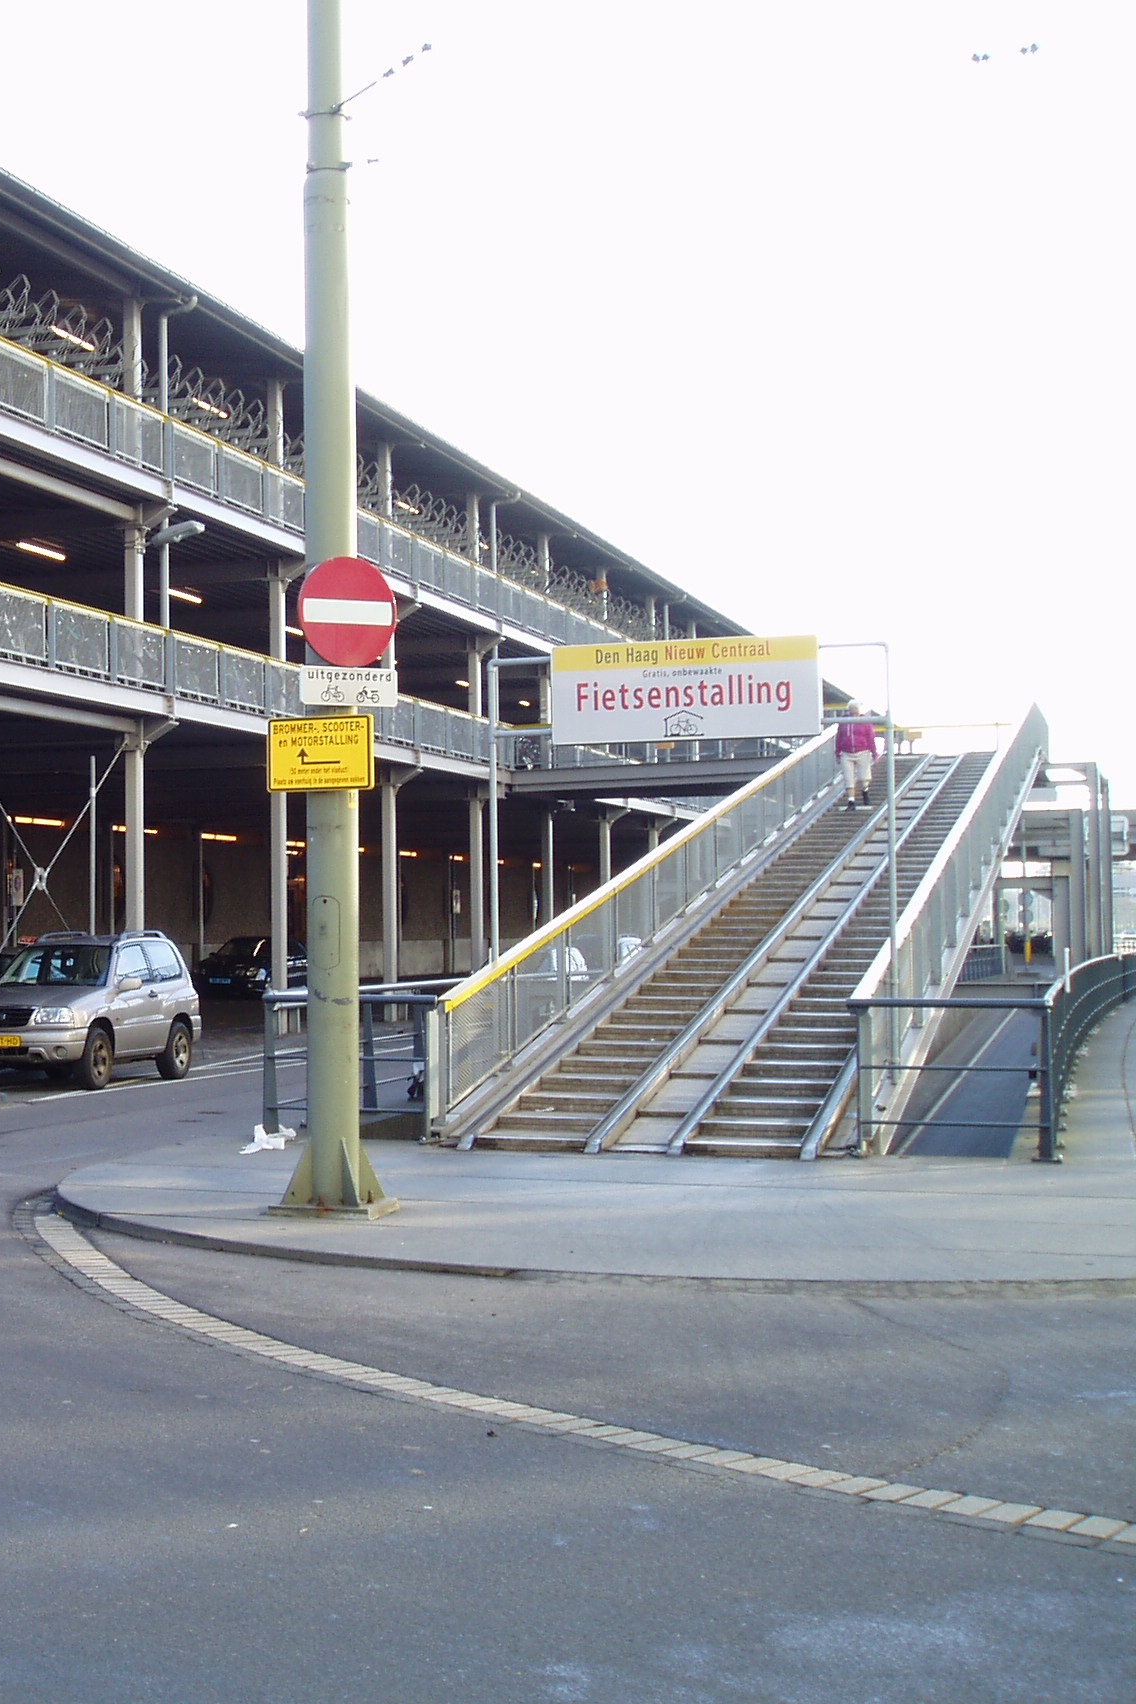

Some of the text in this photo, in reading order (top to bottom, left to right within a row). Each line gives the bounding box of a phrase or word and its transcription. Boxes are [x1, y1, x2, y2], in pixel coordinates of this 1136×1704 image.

[595, 640, 772, 665] Den Haag Nieuw Centraal
[307, 669, 392, 683] uitgezonderd
[642, 666, 723, 678] Gratis, onbewaakte
[576, 674, 793, 712] Fietsenstalling
[322, 720, 365, 732] SCOOTER-
[278, 734, 359, 748] en MOTORSTALLING
